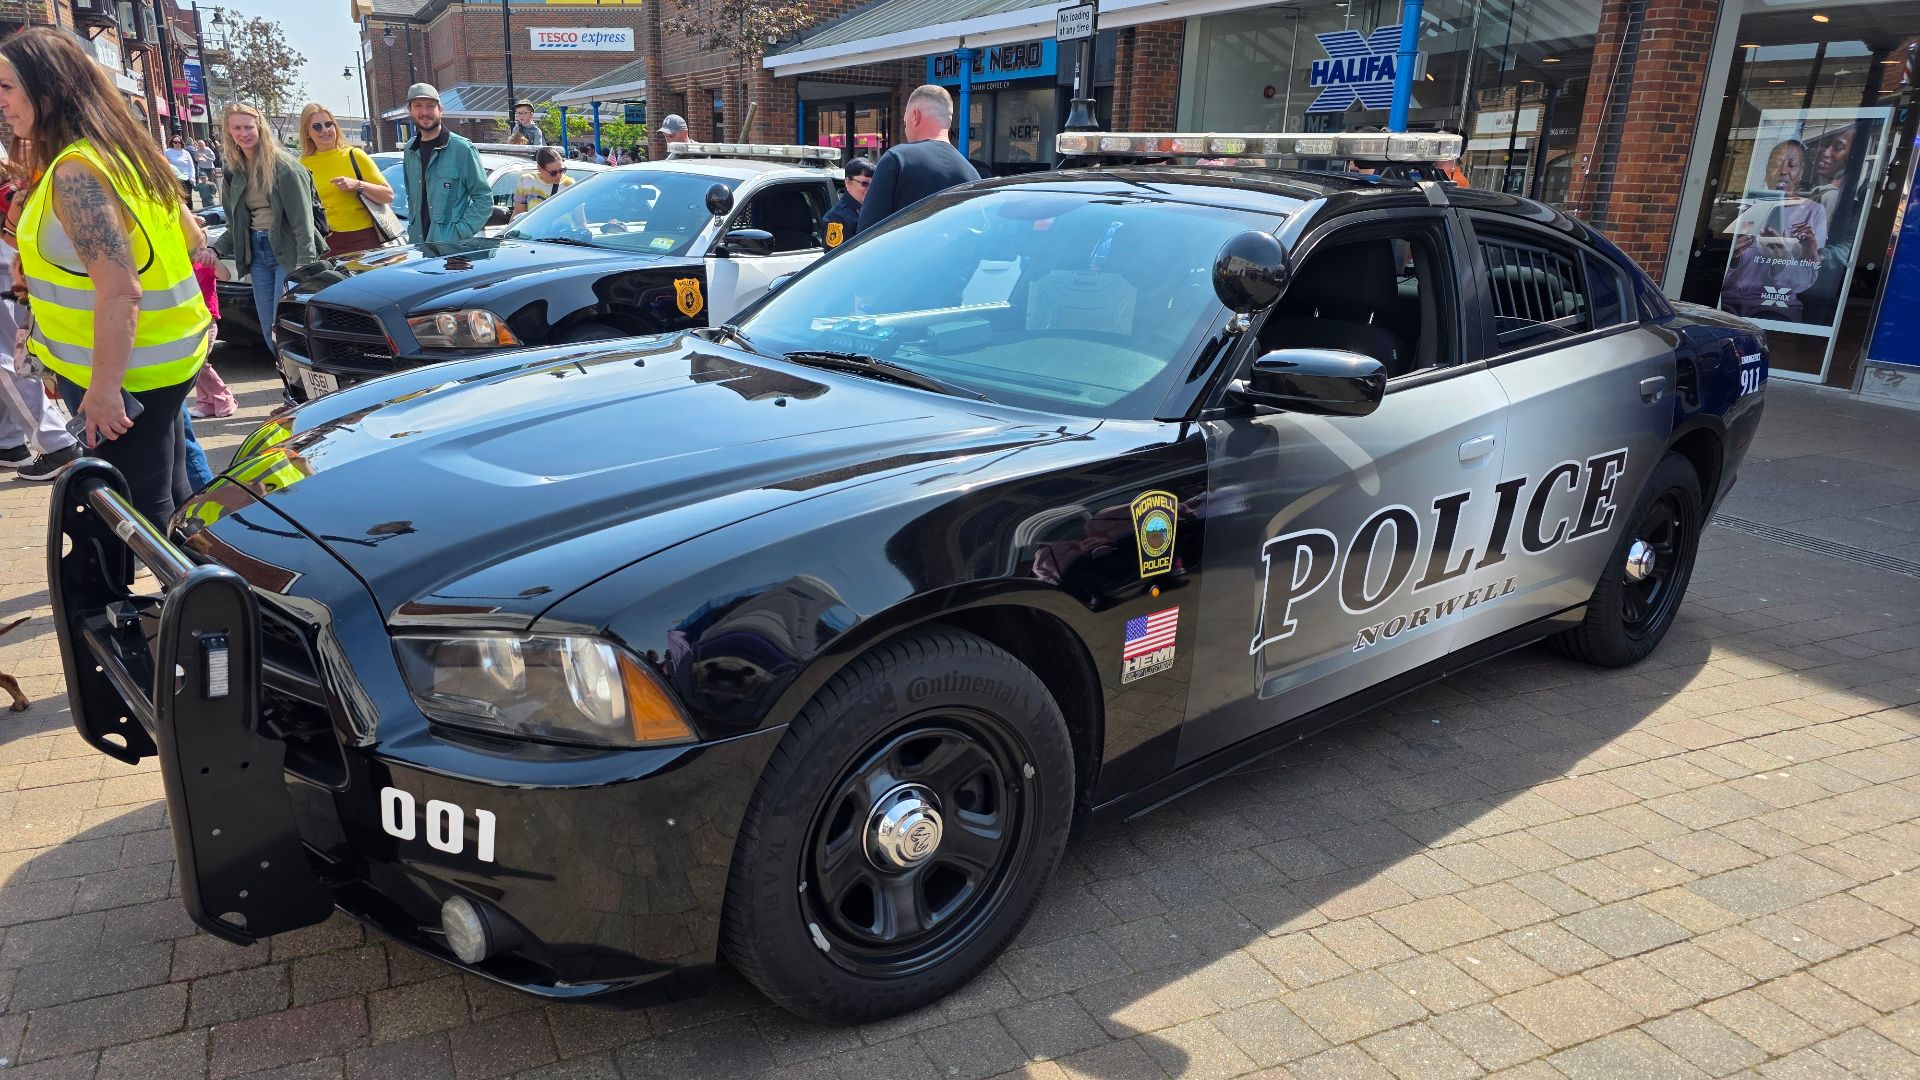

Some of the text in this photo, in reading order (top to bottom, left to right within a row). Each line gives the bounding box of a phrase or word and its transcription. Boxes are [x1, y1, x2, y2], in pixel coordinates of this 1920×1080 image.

[1059, 23, 1089, 36] at any time
[1061, 9, 1089, 23] No loading
[538, 31, 626, 47] TESCO express
[990, 42, 1042, 72] NERO
[1311, 54, 1398, 86] HALIFA
[1009, 125, 1040, 139] NERO
[1754, 255, 1765, 264] It's
[1771, 257, 1798, 267] people
[1761, 292, 1791, 302] HALIFAX
[1741, 366, 1760, 397] 911
[1135, 495, 1175, 521] NORWELL
[1143, 556, 1170, 571] POLICE
[1249, 446, 1629, 655] POLICE
[1352, 574, 1519, 653] NORWELL
[1124, 645, 1175, 673] HEMI
[906, 670, 1022, 707] Continental
[381, 787, 496, 863] 001
